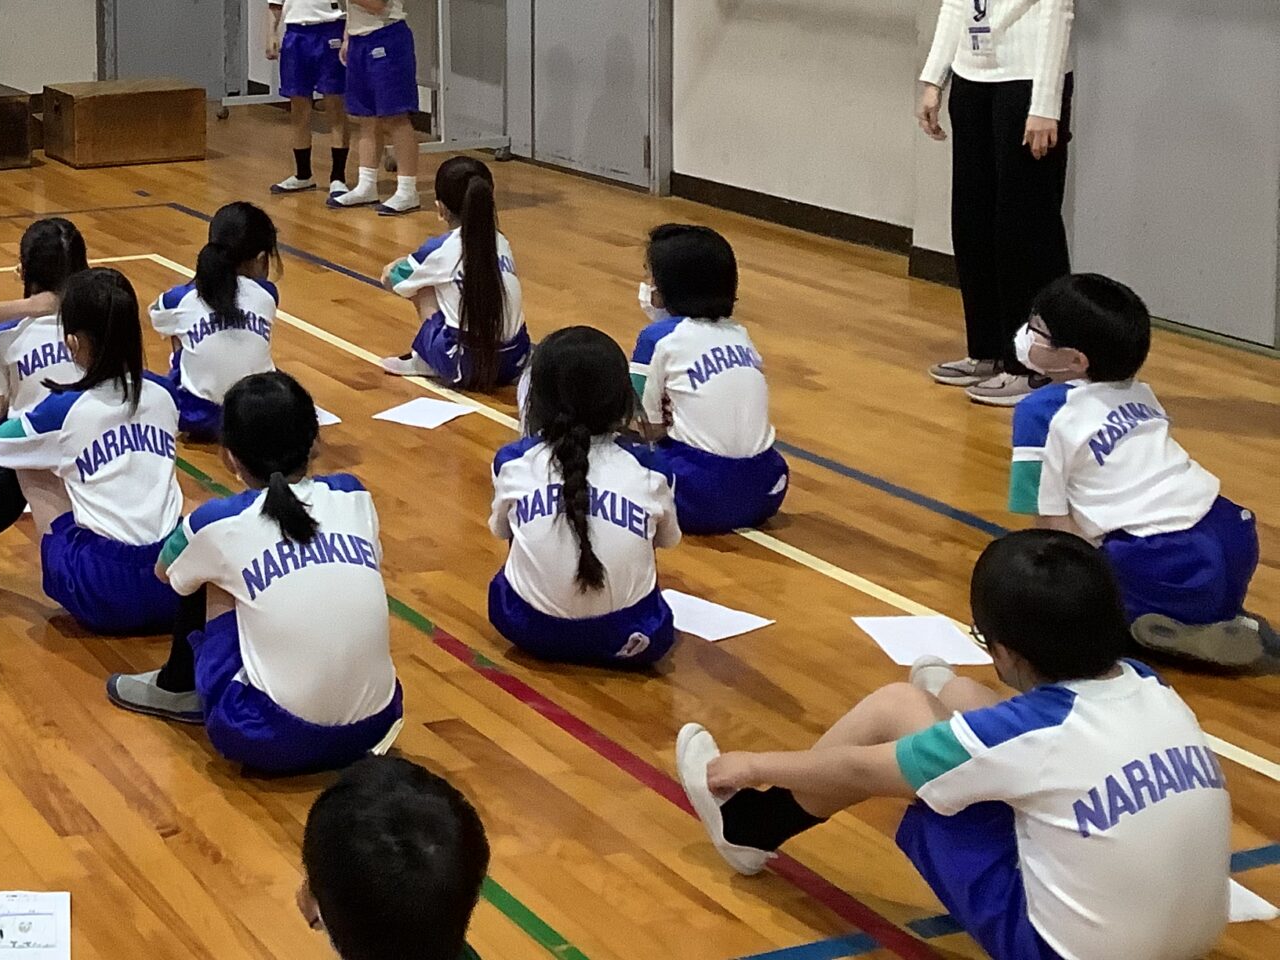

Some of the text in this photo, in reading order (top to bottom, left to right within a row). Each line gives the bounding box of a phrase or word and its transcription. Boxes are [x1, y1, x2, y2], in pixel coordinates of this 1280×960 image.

[187, 309, 272, 349] NARAIKUE
[75, 423, 175, 483] NARAIKUE
[516, 483, 651, 540] NARKUEI
[1072, 745, 1226, 838] NARAIKU
